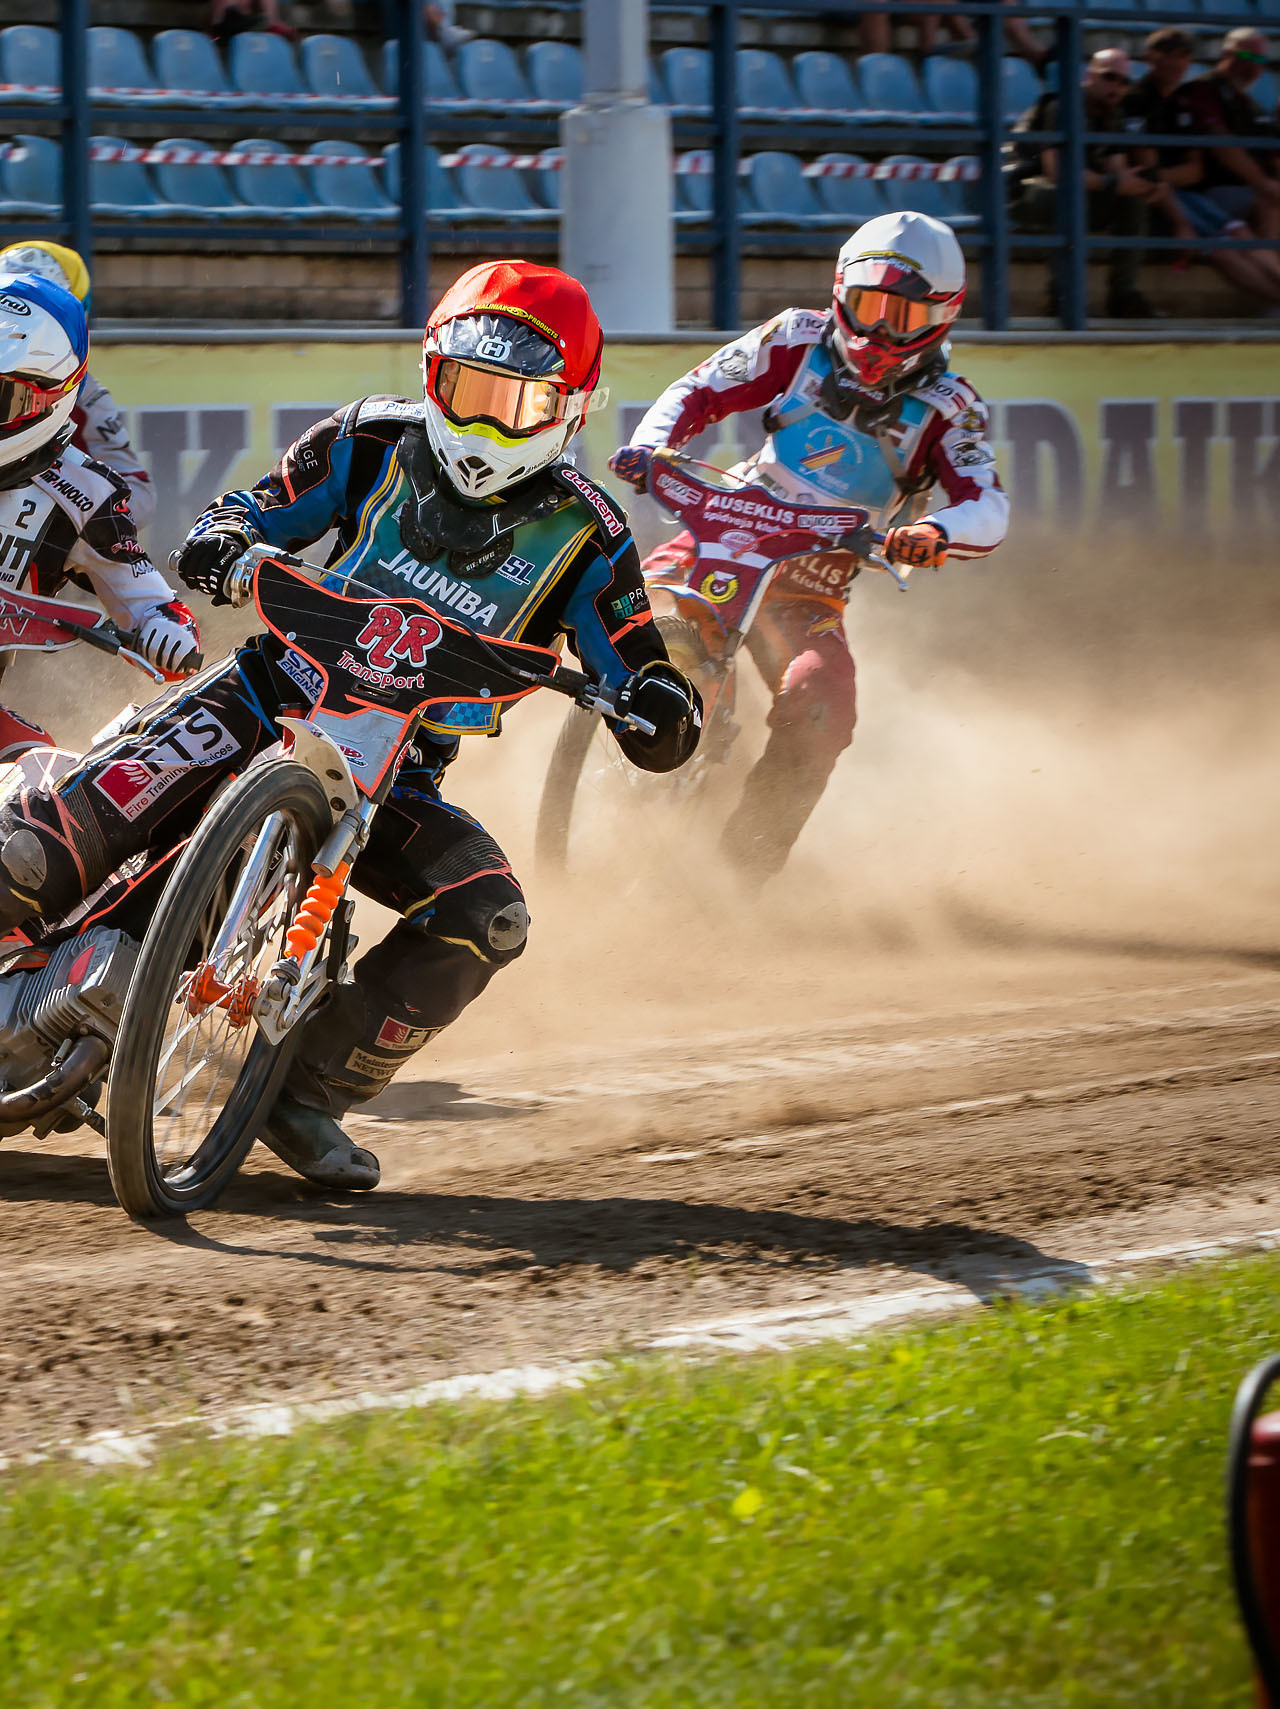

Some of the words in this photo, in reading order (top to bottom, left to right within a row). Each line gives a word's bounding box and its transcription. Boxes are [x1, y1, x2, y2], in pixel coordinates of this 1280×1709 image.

[527, 314, 559, 339] PRODUCTS
[15, 499, 36, 529] 2
[561, 469, 625, 537] dankemi
[708, 494, 795, 524] AUSEKLIS
[501, 555, 534, 584] SL
[377, 548, 499, 627] JAUNĪBA
[336, 650, 425, 689] Transport
[125, 797, 149, 819] Fire
[146, 765, 191, 798] Training
[404, 1028, 444, 1044] FT
